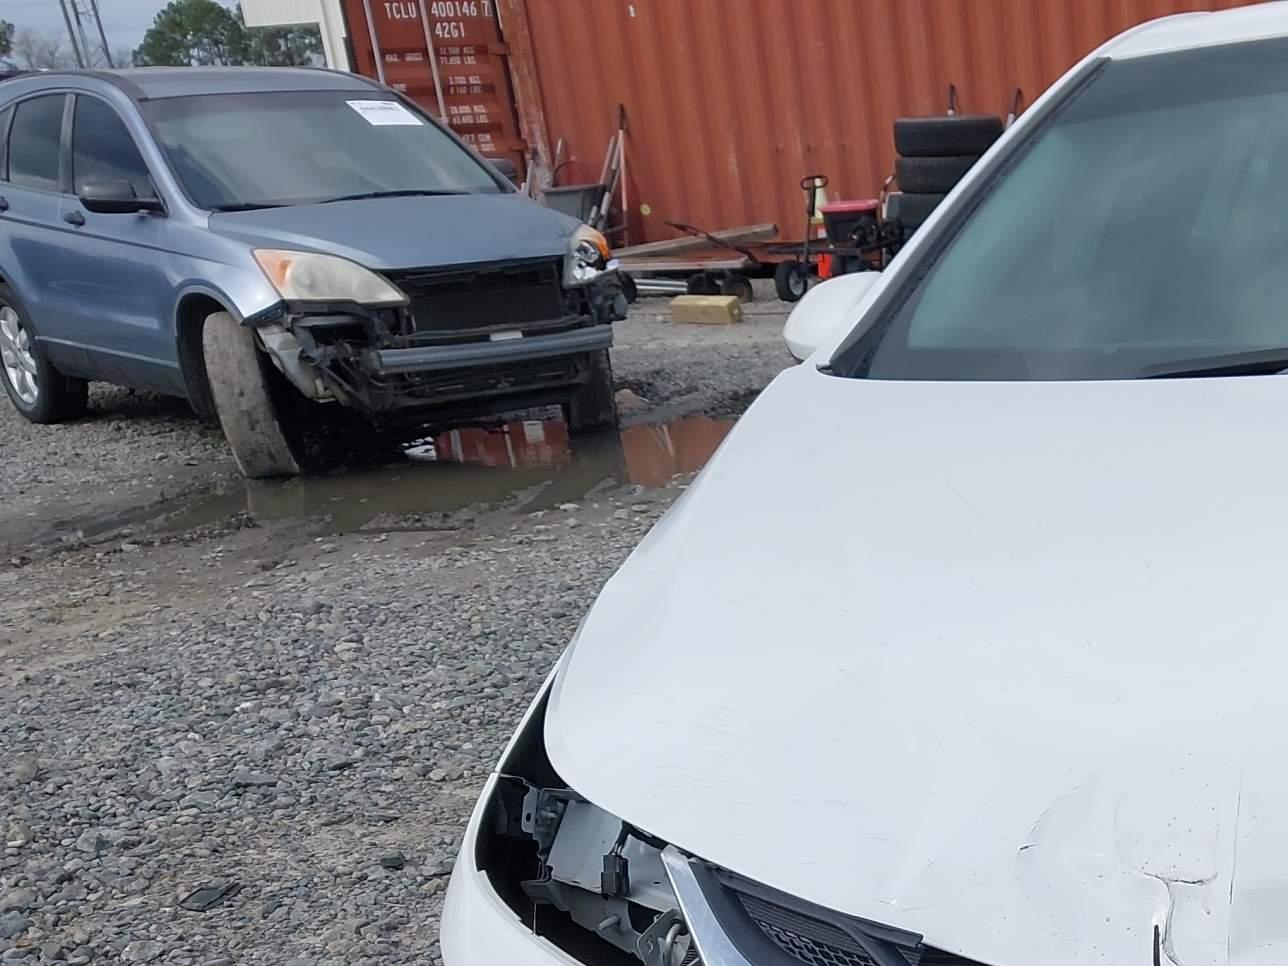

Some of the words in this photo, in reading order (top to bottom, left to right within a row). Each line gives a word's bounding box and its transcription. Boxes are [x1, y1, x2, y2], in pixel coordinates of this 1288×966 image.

[384, 2, 417, 19] TCLU
[431, 1, 477, 17] 400146
[435, 22, 465, 38] 42G1
